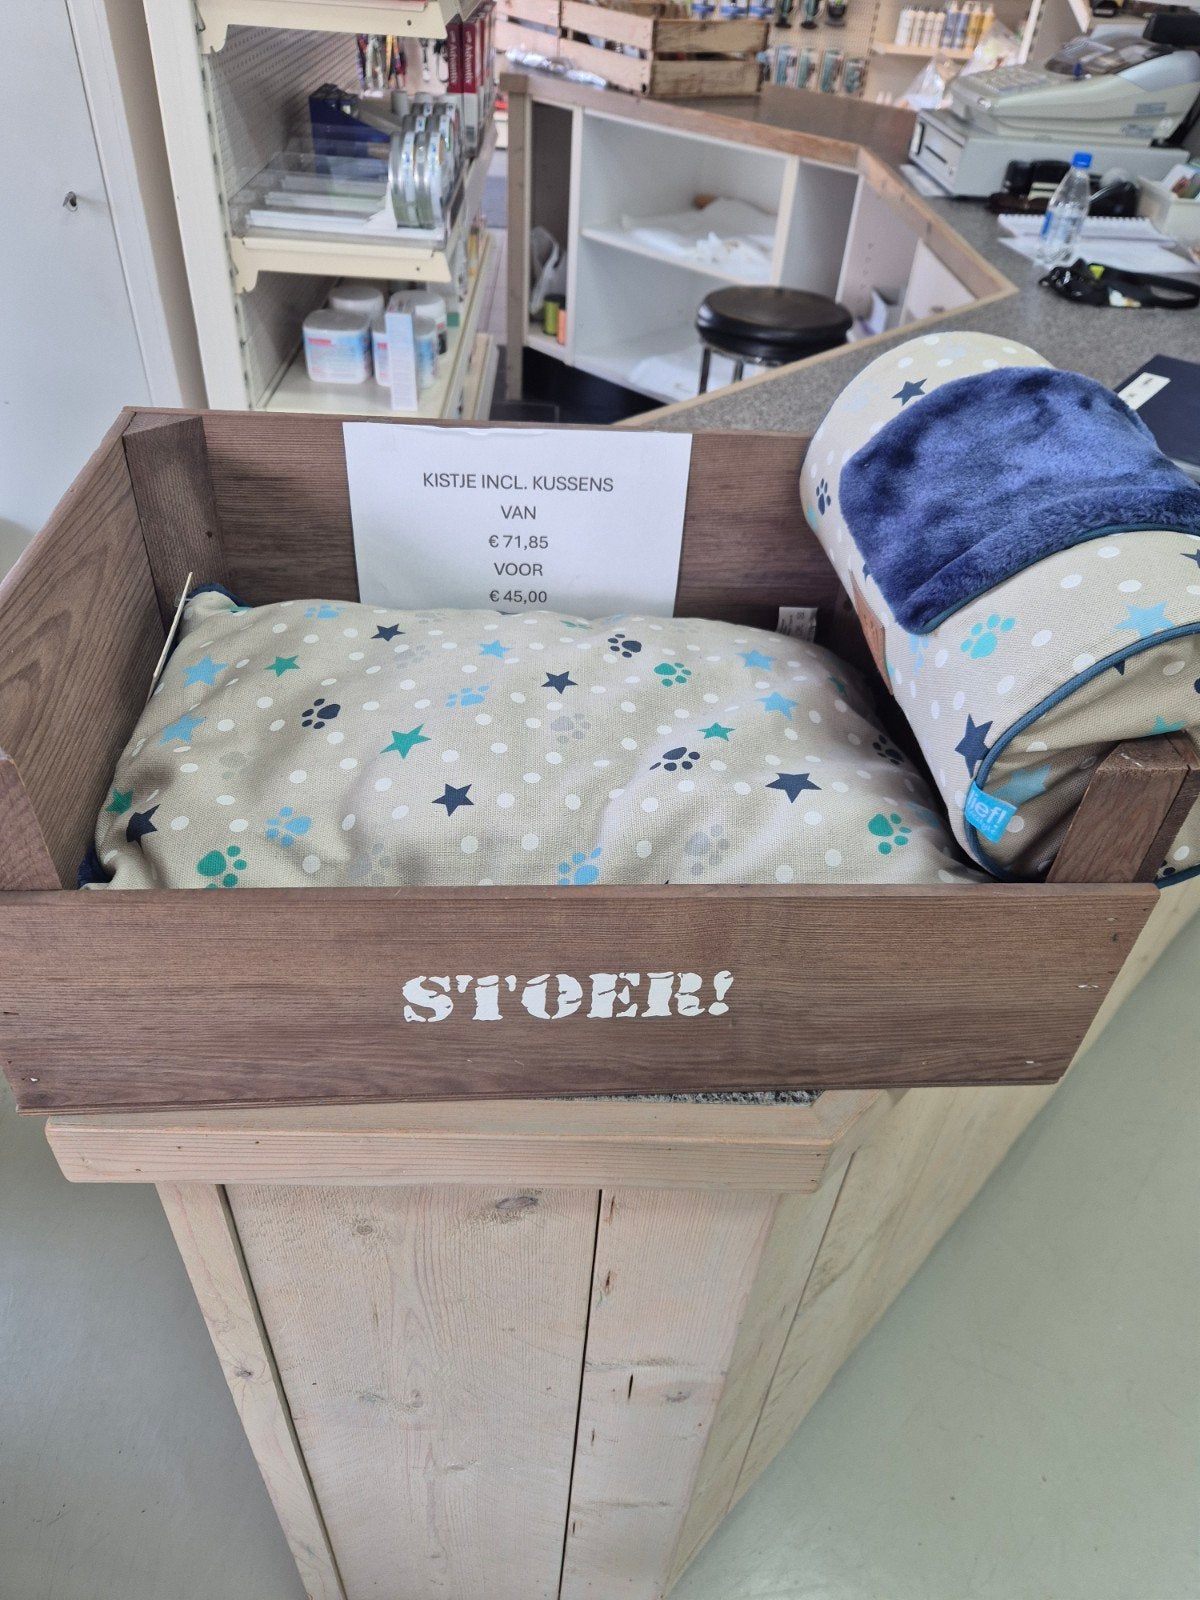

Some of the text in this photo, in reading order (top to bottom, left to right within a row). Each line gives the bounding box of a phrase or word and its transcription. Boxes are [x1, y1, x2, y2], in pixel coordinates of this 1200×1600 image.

[464, 43, 474, 84] Advantix
[424, 473, 613, 492] KISTJE INCL. KUSSENS
[501, 505, 536, 520] VAN
[494, 563, 543, 576] VOOR
[402, 971, 733, 1022] STOER!
